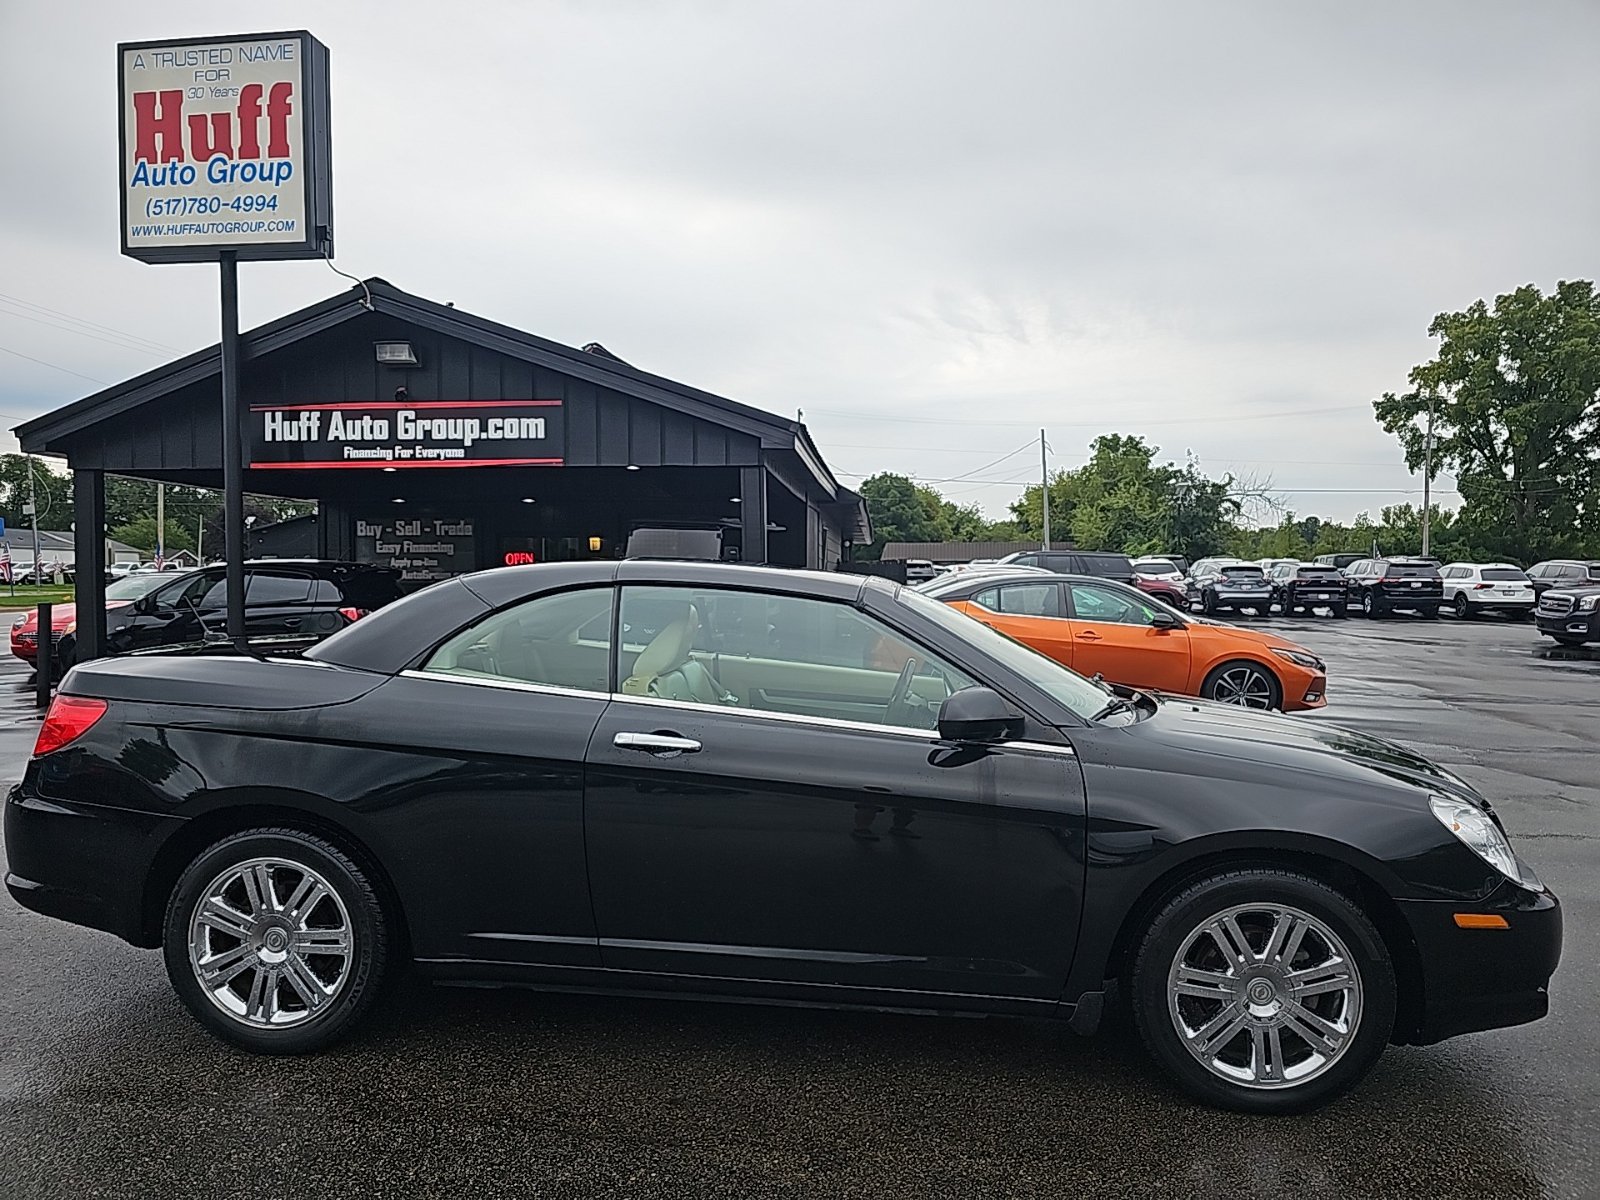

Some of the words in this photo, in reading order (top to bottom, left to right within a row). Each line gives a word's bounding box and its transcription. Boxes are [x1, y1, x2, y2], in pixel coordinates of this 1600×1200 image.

[132, 53, 146, 70] A
[151, 48, 233, 69] TRUSTED
[239, 44, 294, 63] NAME
[194, 69, 231, 82] FOR
[187, 87, 204, 99] 30
[208, 86, 239, 98] Years
[133, 82, 293, 165] Huff
[131, 161, 196, 187] Auto
[207, 156, 293, 187] Group
[145, 194, 278, 218] (517)780-4994
[131, 220, 295, 237] WWW.HUFFAUTOGROUP.COM
[264, 411, 321, 441] Huff
[327, 411, 389, 441] Auto
[397, 410, 546, 447] Group.com
[343, 446, 393, 461] Financing
[394, 445, 414, 459] For
[415, 445, 465, 460] Everyone
[356, 520, 383, 540] Buy
[395, 520, 421, 536] Sell
[433, 520, 473, 536] Trade
[376, 541, 401, 556] Easy
[403, 541, 454, 556] Financing
[505, 552, 534, 566] OPEN
